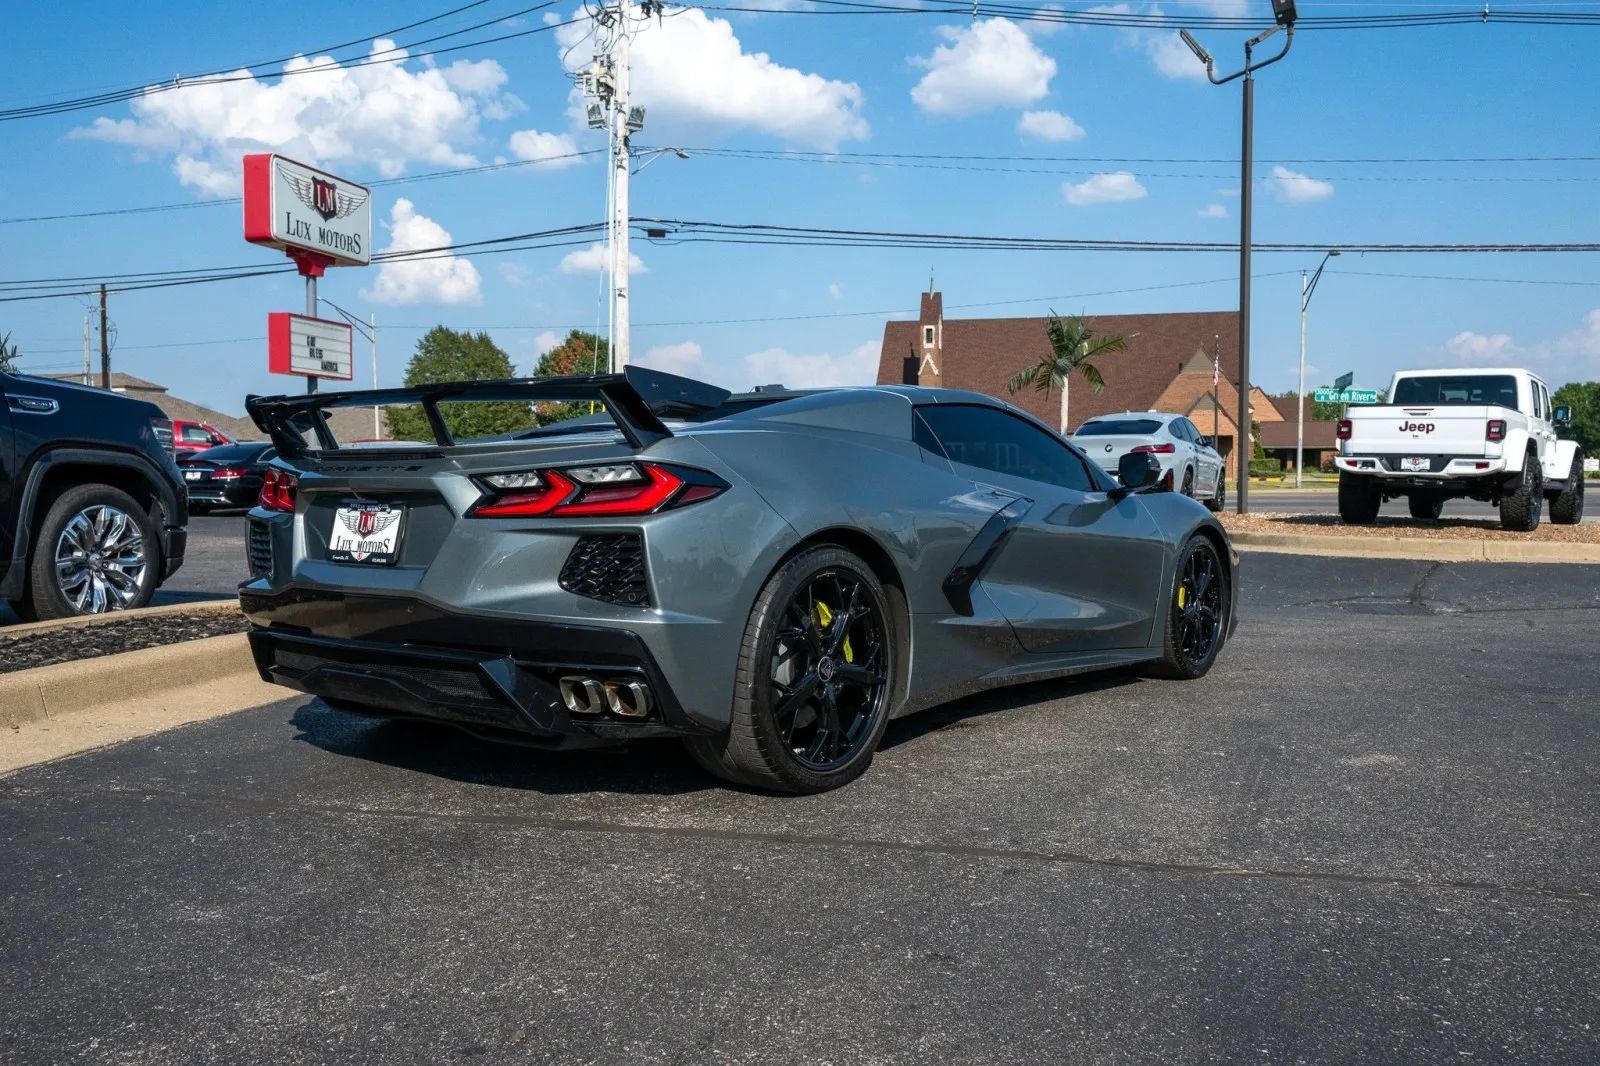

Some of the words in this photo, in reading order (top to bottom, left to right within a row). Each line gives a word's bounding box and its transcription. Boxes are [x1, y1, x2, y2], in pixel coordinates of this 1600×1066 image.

[317, 184, 334, 212] LM
[286, 212, 311, 241] LUX
[318, 227, 361, 254] MOTORS
[321, 361, 338, 372] AMERICA
[1351, 391, 1371, 402] River
[1399, 421, 1435, 434] Jeep
[360, 515, 374, 533] LM
[357, 538, 391, 554] MOTORS
